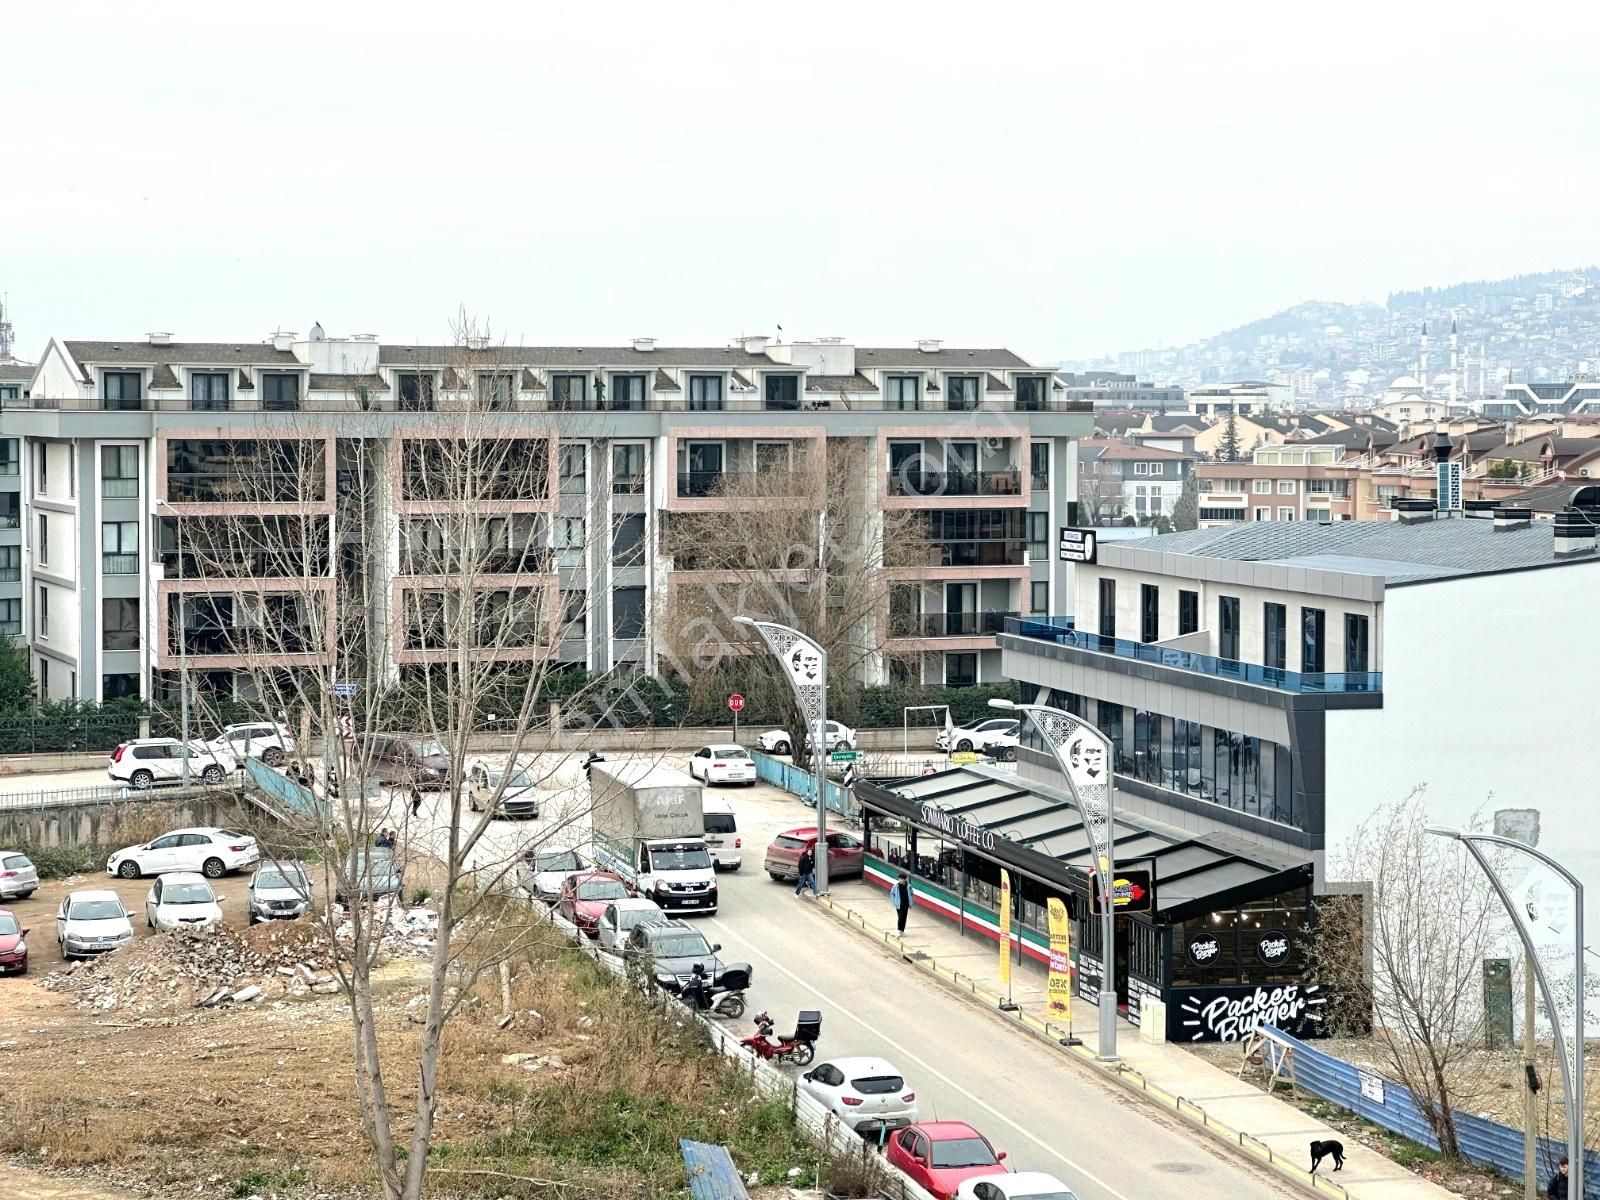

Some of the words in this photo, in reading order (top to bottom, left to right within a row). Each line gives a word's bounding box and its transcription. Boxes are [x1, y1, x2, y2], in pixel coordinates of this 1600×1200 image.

[729, 699, 744, 707] DUR
[921, 805, 954, 834] SOMMARO
[956, 821, 981, 846] COFFEE
[982, 830, 996, 851] CO.
[1201, 985, 1298, 1031] Packet
[1214, 997, 1306, 1042] Burger
